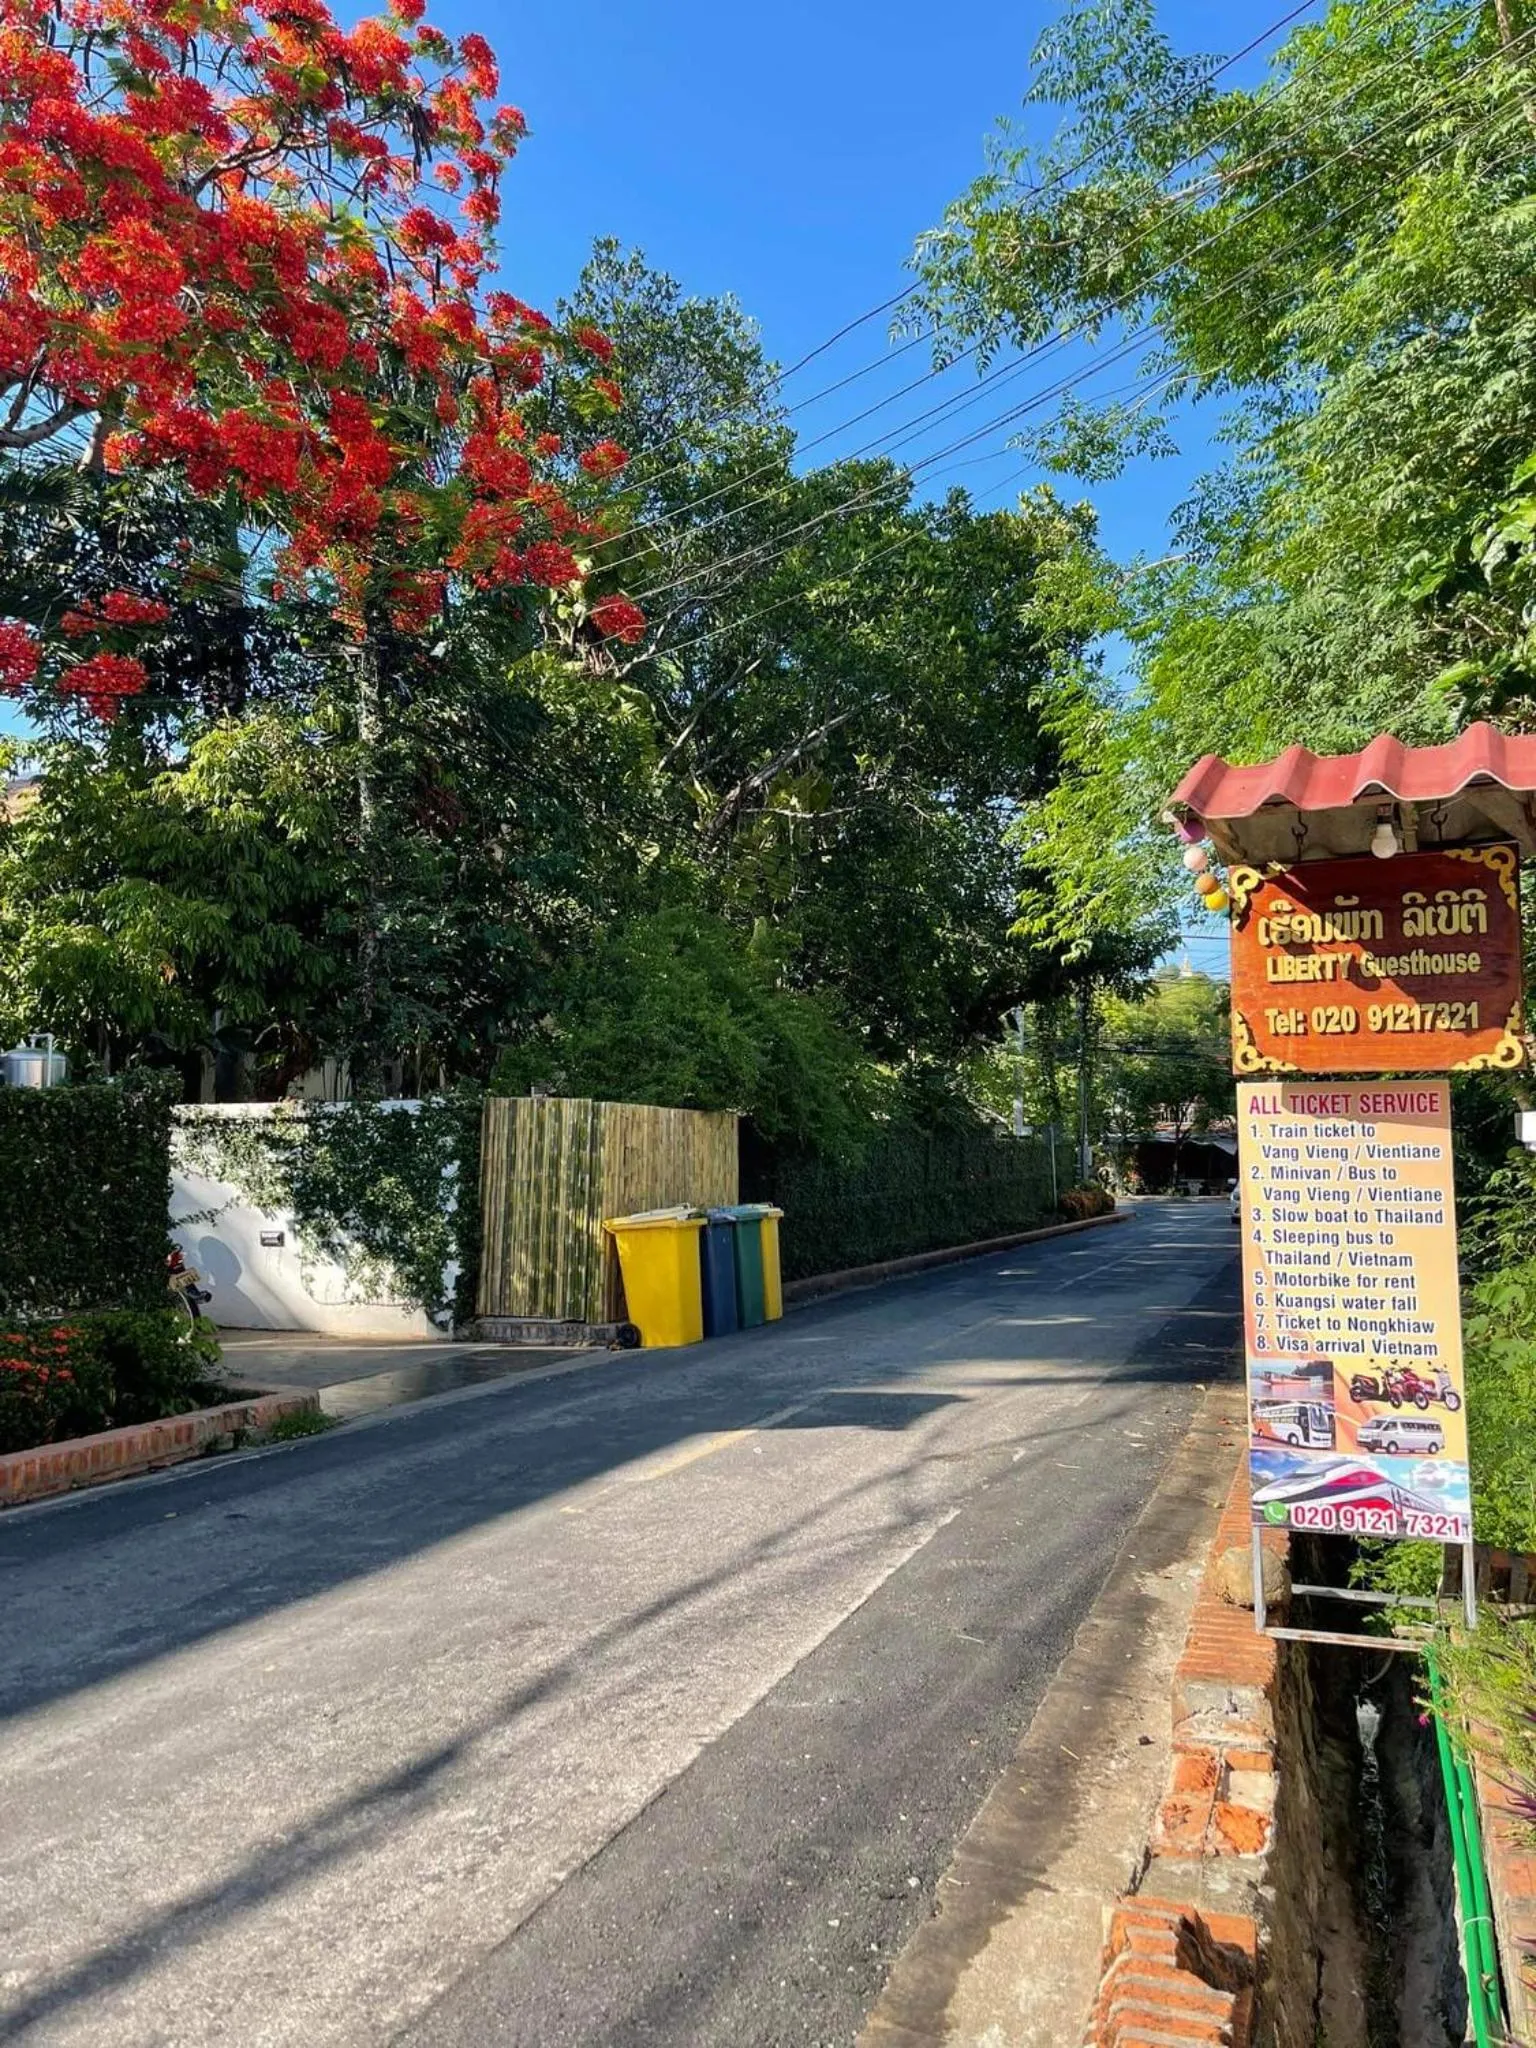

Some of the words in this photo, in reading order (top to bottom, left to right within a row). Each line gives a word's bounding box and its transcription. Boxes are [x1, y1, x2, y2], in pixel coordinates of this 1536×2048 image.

[1266, 952, 1352, 982] LIBERTY
[1360, 949, 1481, 978] Guesthouse
[1264, 1008, 1305, 1035] Tel:
[1311, 1005, 1357, 1033] 020
[1368, 1001, 1479, 1032] 91217321
[1249, 1095, 1281, 1114] ALL
[1290, 1094, 1352, 1114] TICKET
[1360, 1092, 1440, 1113] SERVICE
[1250, 1124, 1263, 1138] 1.
[1270, 1124, 1307, 1138] Train
[1314, 1123, 1355, 1138] ticket
[1361, 1123, 1375, 1137] to
[1262, 1145, 1299, 1161] Vang
[1306, 1145, 1349, 1161] Vieng
[1355, 1145, 1361, 1160] /
[1366, 1144, 1441, 1159] Vientiane
[1251, 1166, 1264, 1180] 2.
[1271, 1166, 1331, 1180] Minivan
[1337, 1166, 1343, 1181] /
[1349, 1166, 1376, 1180] Bus
[1383, 1167, 1397, 1180] to
[1263, 1187, 1300, 1203] Vang
[1307, 1187, 1350, 1204] Vieng
[1356, 1187, 1362, 1202] /
[1368, 1187, 1442, 1201] Vientiane
[1252, 1208, 1265, 1223] 3.
[1272, 1208, 1308, 1223] Slow
[1315, 1209, 1348, 1223] boat
[1354, 1210, 1368, 1223] to
[1374, 1209, 1443, 1224] Thailand
[1253, 1229, 1266, 1243] 4.
[1273, 1229, 1340, 1247] Sleeping
[1346, 1230, 1373, 1245] bus
[1380, 1231, 1394, 1245] to
[1265, 1250, 1331, 1266] Thailand
[1337, 1252, 1343, 1267] /
[1348, 1252, 1413, 1267] Vietnam
[1255, 1271, 1268, 1286] 5.
[1274, 1272, 1350, 1287] Motorbike
[1357, 1273, 1378, 1288] for
[1385, 1275, 1415, 1289] rent
[1255, 1292, 1268, 1306] 6.
[1275, 1293, 1336, 1311] Kuangsi
[1342, 1296, 1386, 1310] water
[1392, 1296, 1417, 1311] fall
[1256, 1314, 1269, 1328] 7.
[1276, 1314, 1321, 1330] Ticket
[1327, 1316, 1341, 1330] to
[1348, 1317, 1435, 1335] Nongkhiaw
[1257, 1335, 1270, 1350] 8.
[1277, 1336, 1309, 1351] Visa
[1315, 1338, 1365, 1353] arrival
[1372, 1340, 1437, 1356] Vietnam
[1294, 1506, 1333, 1527] 020
[1343, 1508, 1394, 1531] 9121
[1406, 1513, 1460, 1537] 7321
